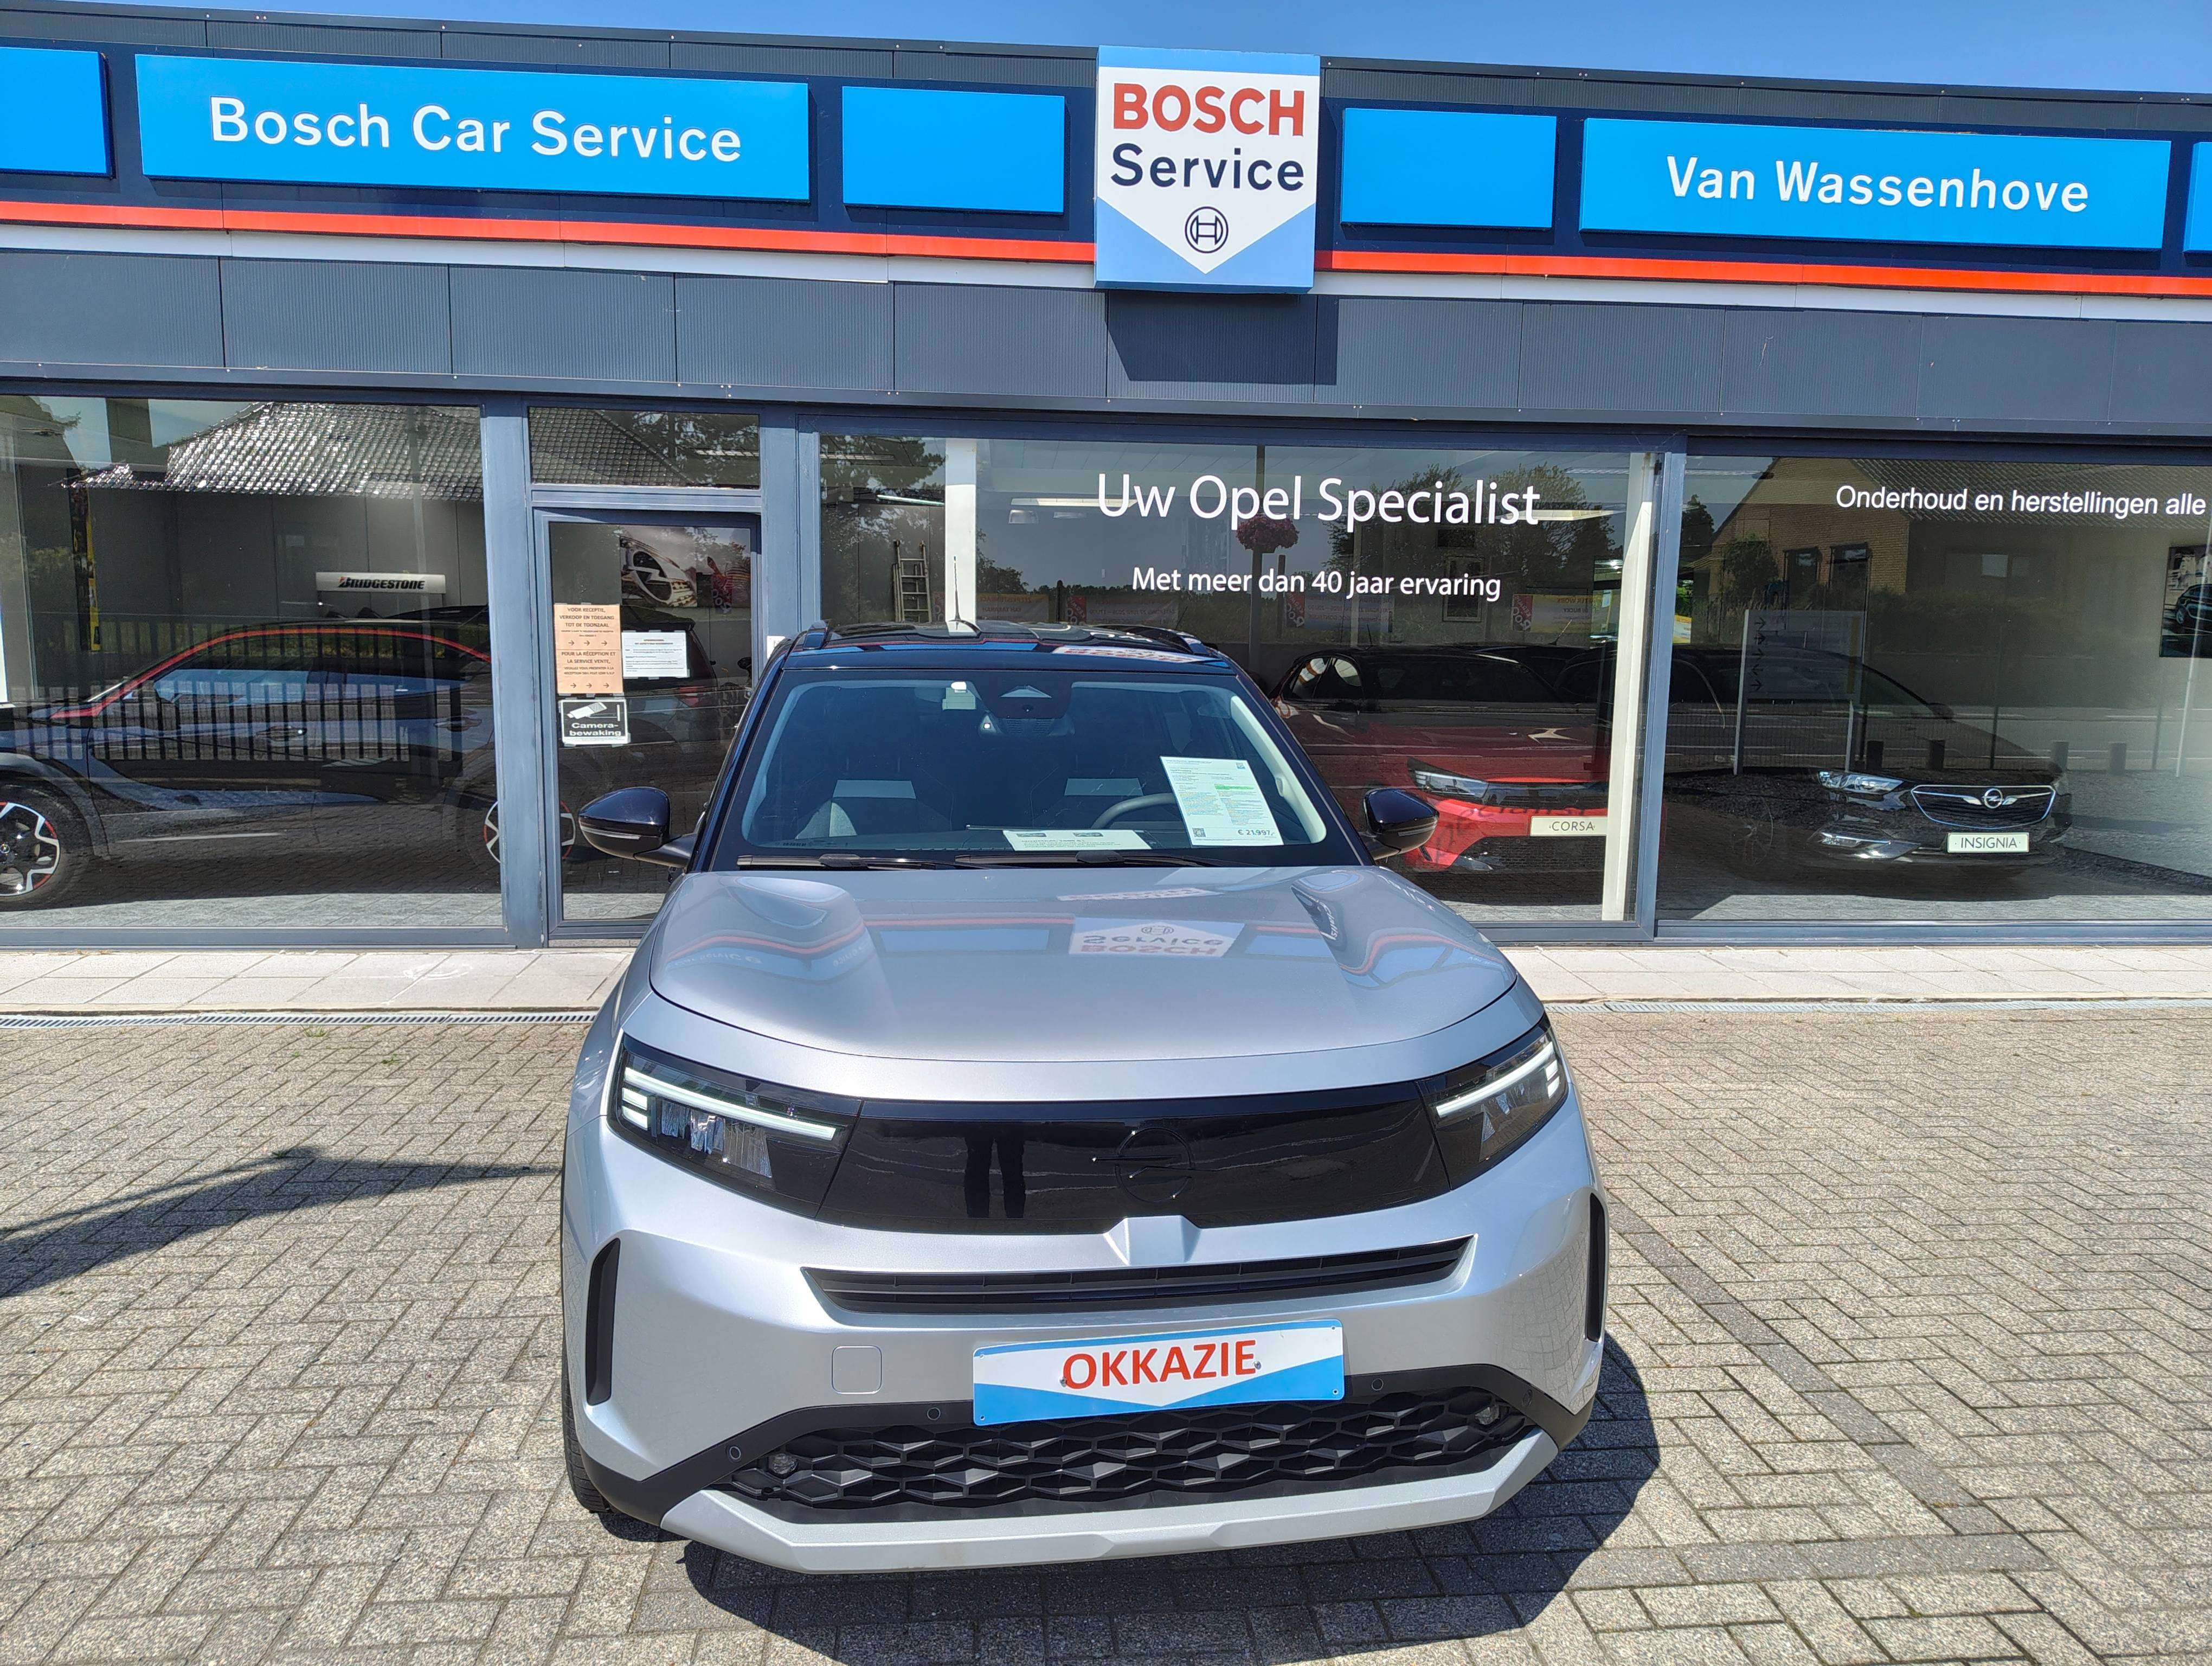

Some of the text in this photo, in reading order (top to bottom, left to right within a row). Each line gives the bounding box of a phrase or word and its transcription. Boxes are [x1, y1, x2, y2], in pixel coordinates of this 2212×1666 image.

[210, 97, 741, 162] Bosch Car Service
[1113, 83, 1304, 137] BOSCH
[1110, 143, 1304, 191] Service
[1667, 155, 2089, 213] Van Wassenhove
[1098, 473, 1540, 533] Uw Opel Specialist
[1836, 485, 2207, 520] Onderhoud en herstellingen alle
[337, 576, 426, 589] BRIDGESTONE
[1132, 567, 1501, 602] Met meer dan 40 jaar ervaring
[1551, 821, 1594, 831] CORSA
[1960, 837, 2018, 849] INSIGNIA
[1062, 1339, 1257, 1390] OKKAZIE
